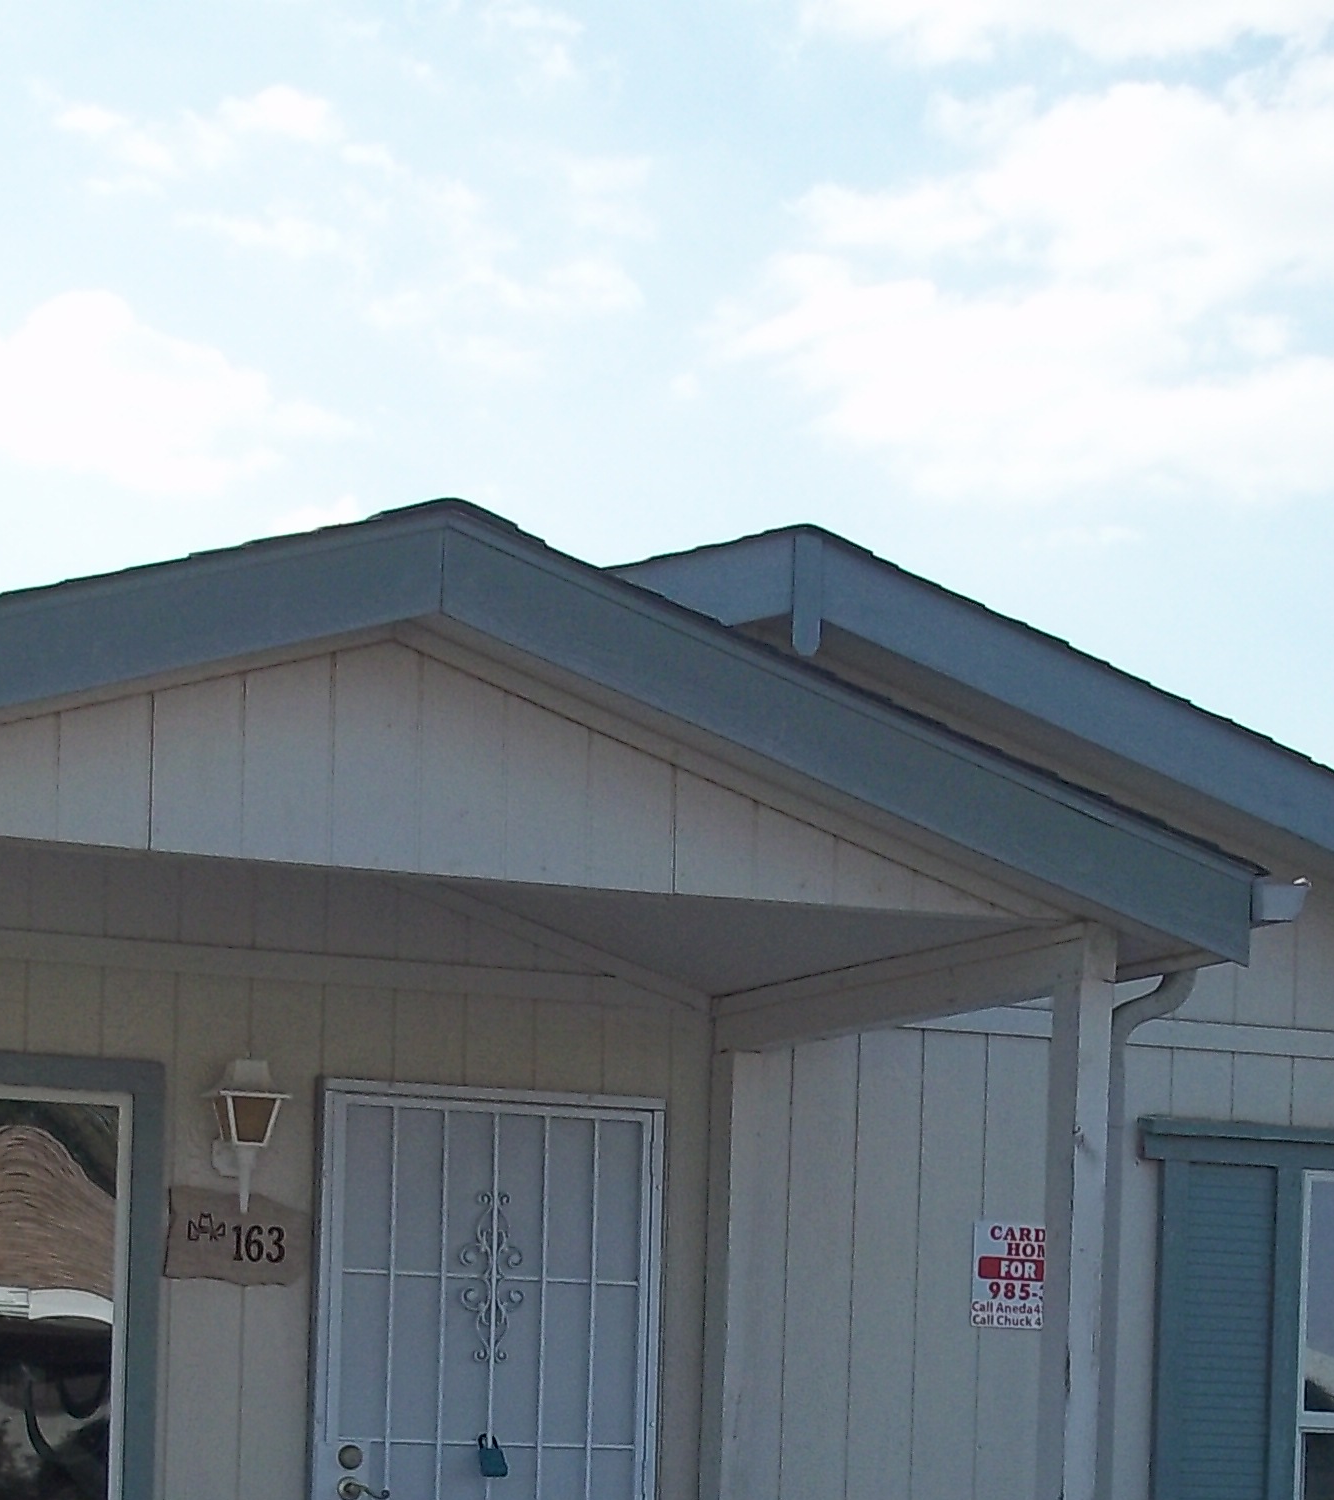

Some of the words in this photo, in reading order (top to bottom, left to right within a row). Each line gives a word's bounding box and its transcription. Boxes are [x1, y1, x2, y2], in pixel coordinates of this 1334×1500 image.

[990, 1226, 1046, 1242] CARD
[232, 1224, 286, 1264] 163
[1000, 1261, 1036, 1279] FOR
[971, 1301, 994, 1313] Call
[972, 1314, 994, 1325] Call
[997, 1315, 1032, 1327] Chuck
